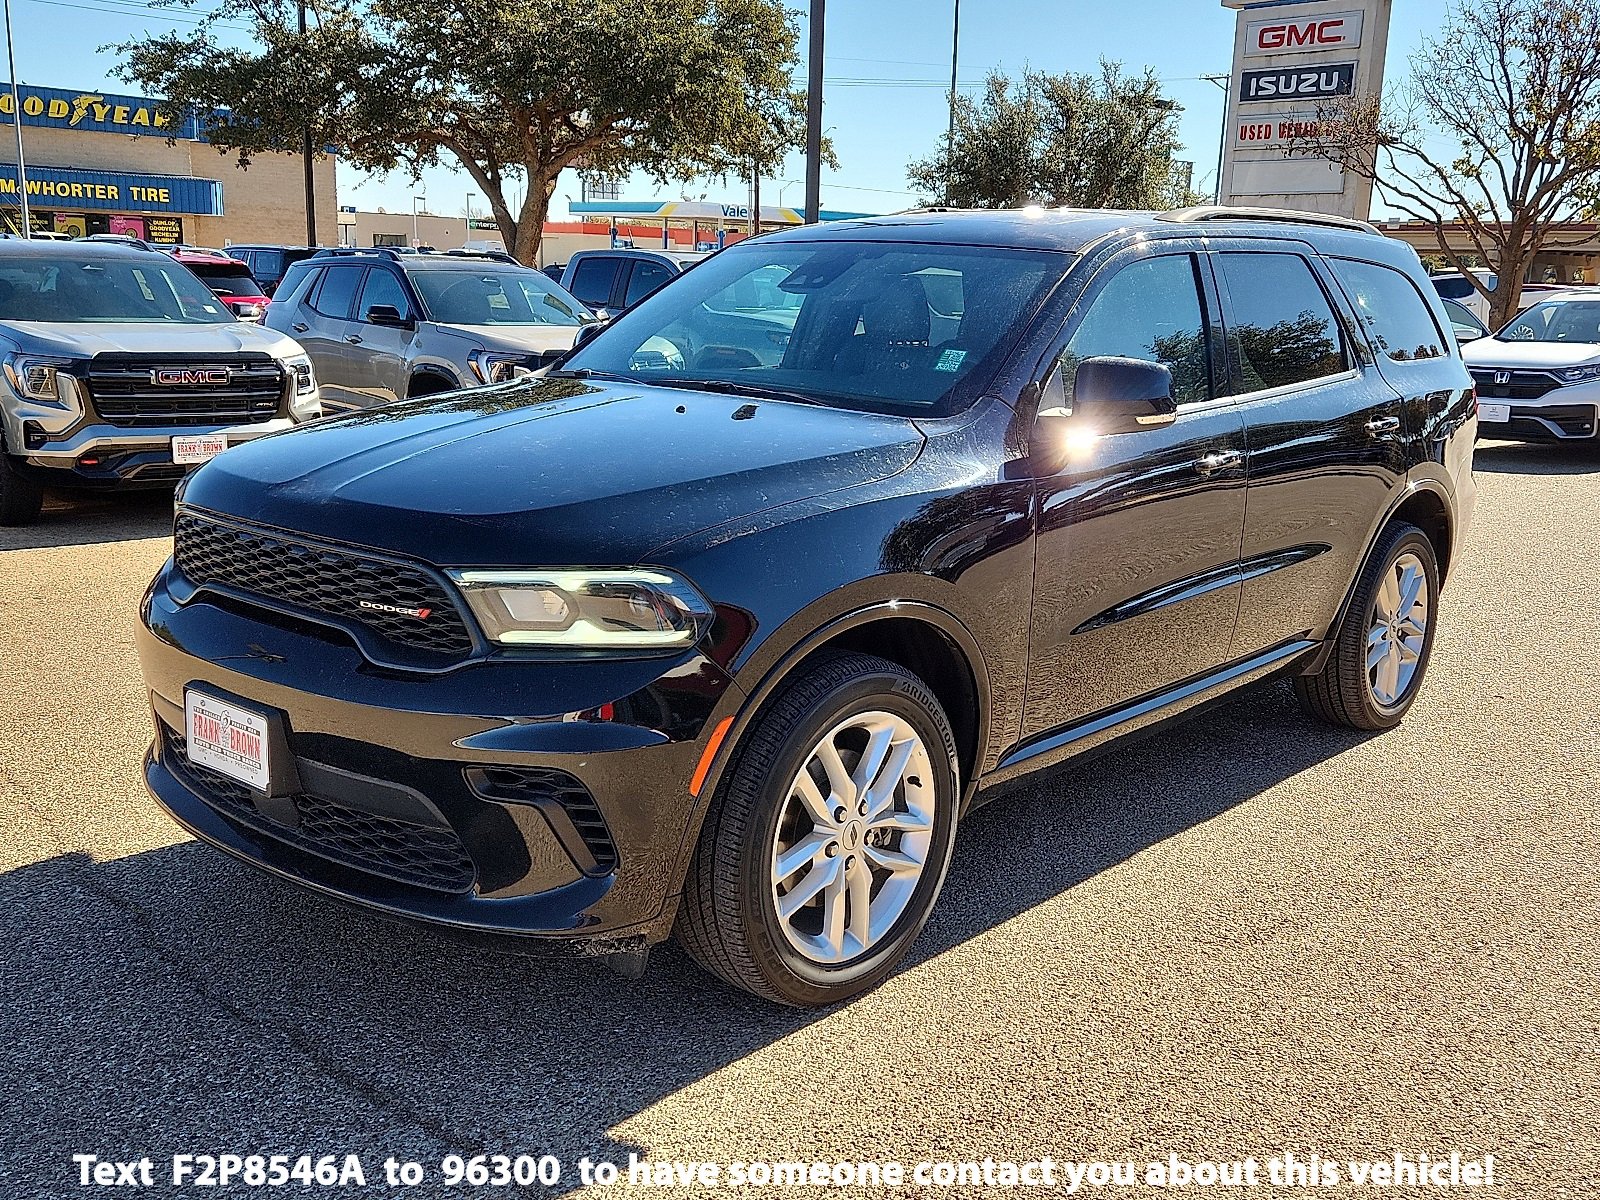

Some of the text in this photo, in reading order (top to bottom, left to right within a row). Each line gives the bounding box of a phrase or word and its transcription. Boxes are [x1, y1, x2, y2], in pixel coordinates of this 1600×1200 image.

[1258, 19, 1345, 49] GMC
[1250, 71, 1339, 97] ISUZU
[1239, 123, 1272, 141] USED
[129, 186, 170, 203] TIRE
[159, 370, 228, 384] GMC
[177, 443, 223, 453] FRANK BROWN
[360, 600, 420, 617] DODGE
[901, 681, 956, 764] BRIDGESTONE
[193, 713, 220, 745] FRANK
[230, 727, 261, 760] BROWN
